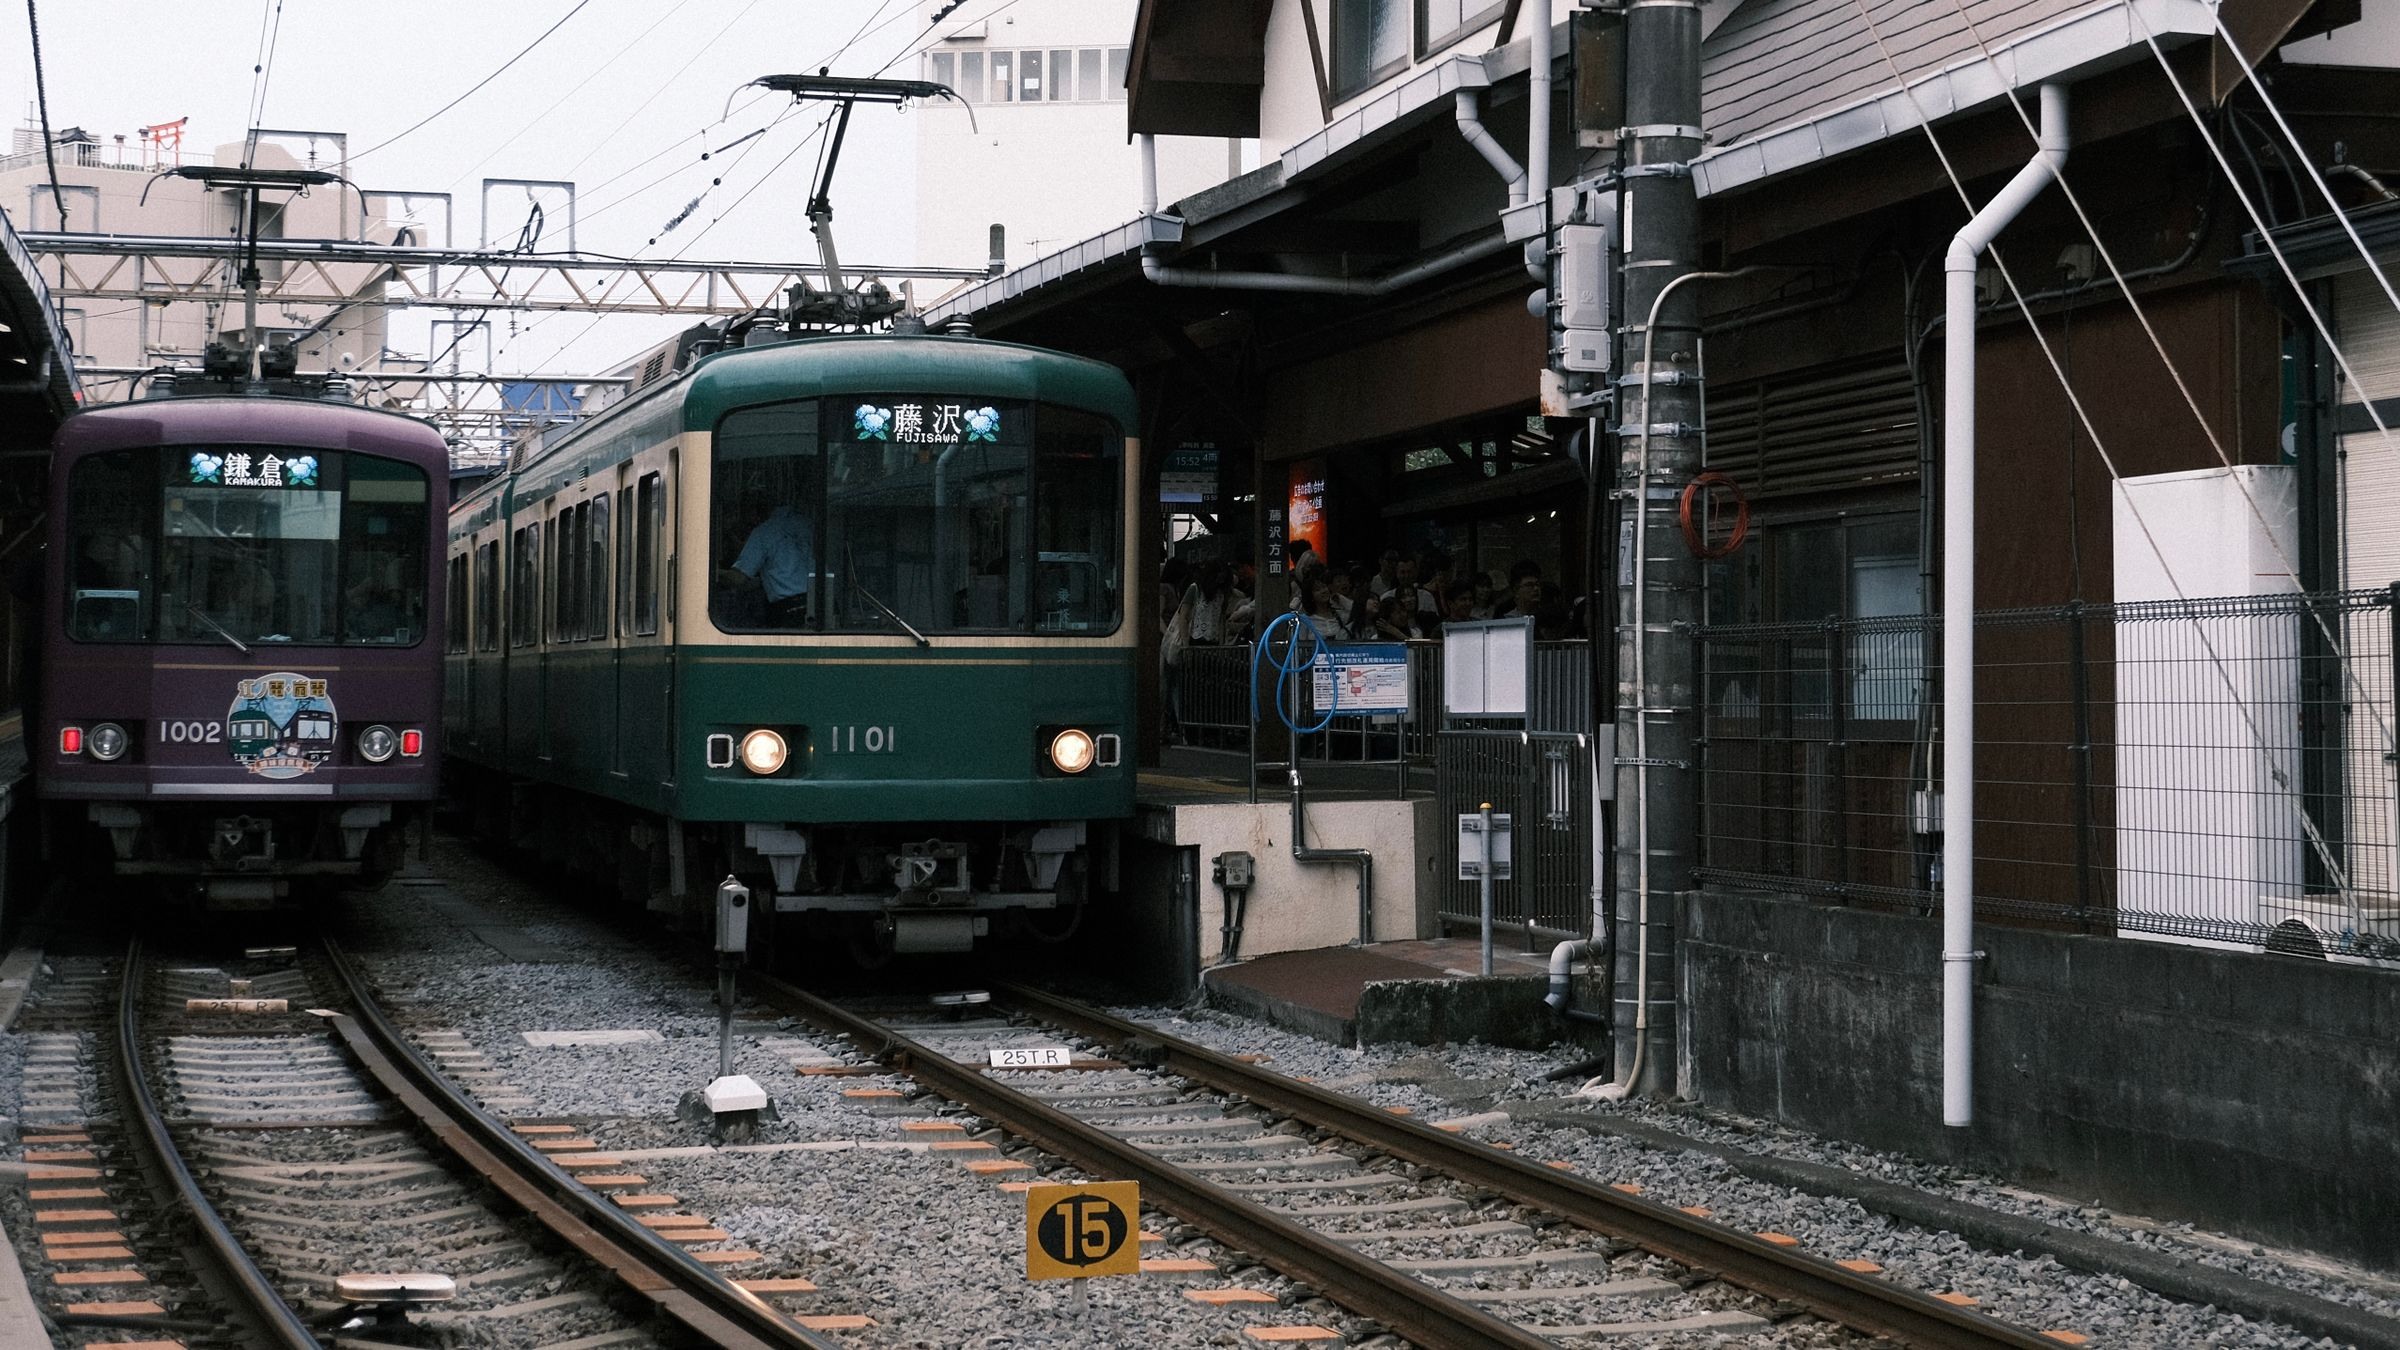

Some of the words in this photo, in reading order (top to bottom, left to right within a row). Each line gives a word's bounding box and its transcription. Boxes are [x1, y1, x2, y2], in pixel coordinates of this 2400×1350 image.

[893, 403, 961, 434] 藤沢
[896, 433, 959, 443] FUJISAWA
[224, 452, 285, 478] 鎌倉
[225, 477, 283, 487] KAMAKURA
[1268, 509, 1282, 574] 藤沢方面
[160, 721, 221, 743] 1002
[832, 726, 894, 752] 1101
[1002, 1049, 1059, 1064] 25T.R
[1056, 1201, 1111, 1259] 15
